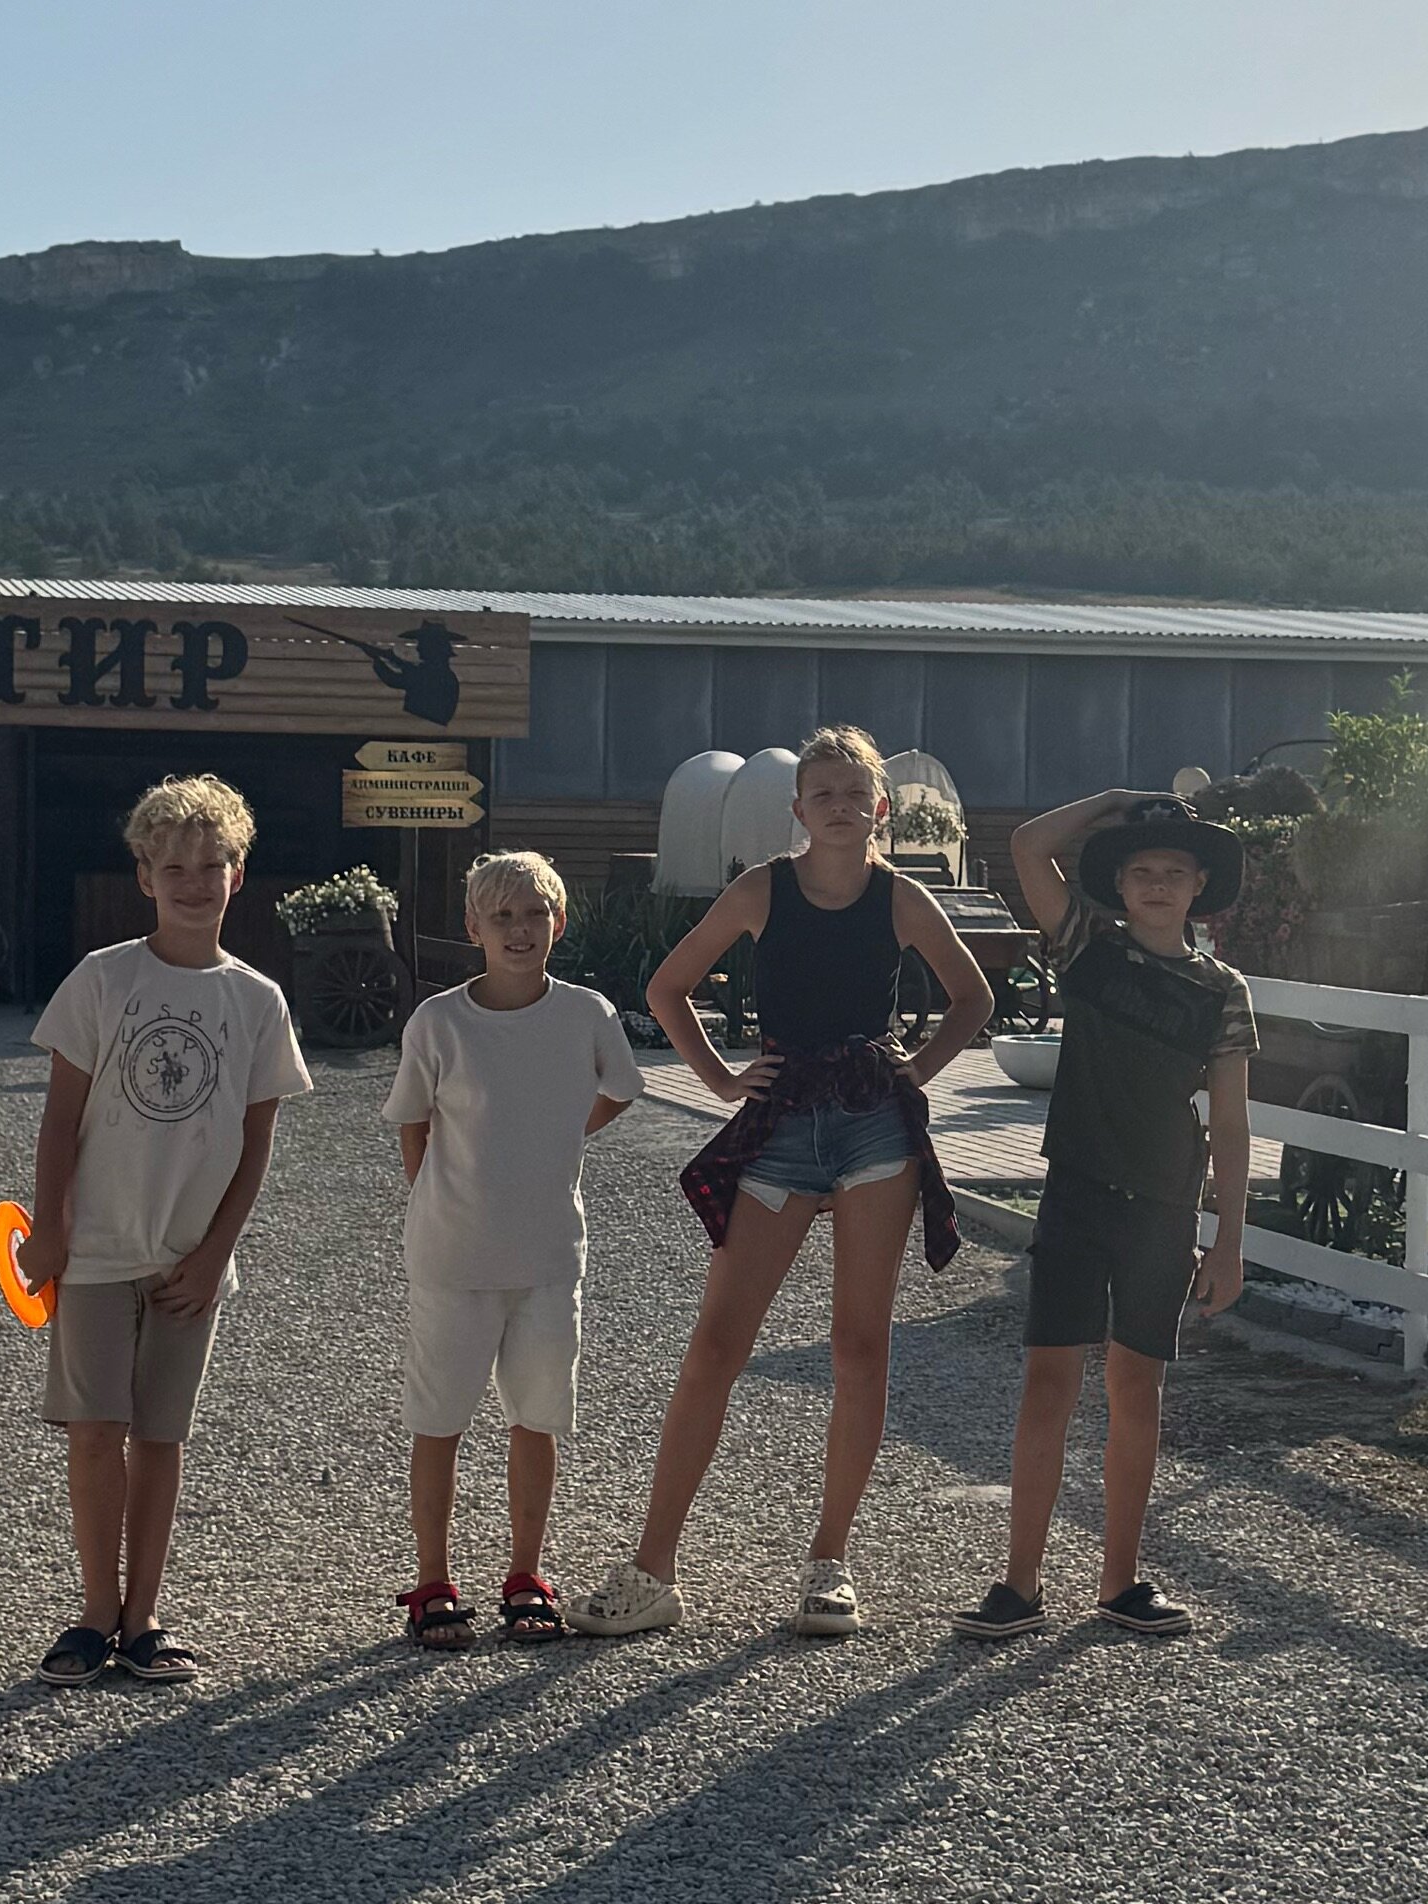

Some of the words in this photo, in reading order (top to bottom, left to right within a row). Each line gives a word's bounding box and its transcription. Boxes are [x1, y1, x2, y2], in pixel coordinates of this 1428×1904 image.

[387, 749, 437, 764] КАФЕ
[349, 778, 470, 793] АДМИНИСТРАЦИЯ
[365, 805, 465, 820] СУВЕНИРЫ
